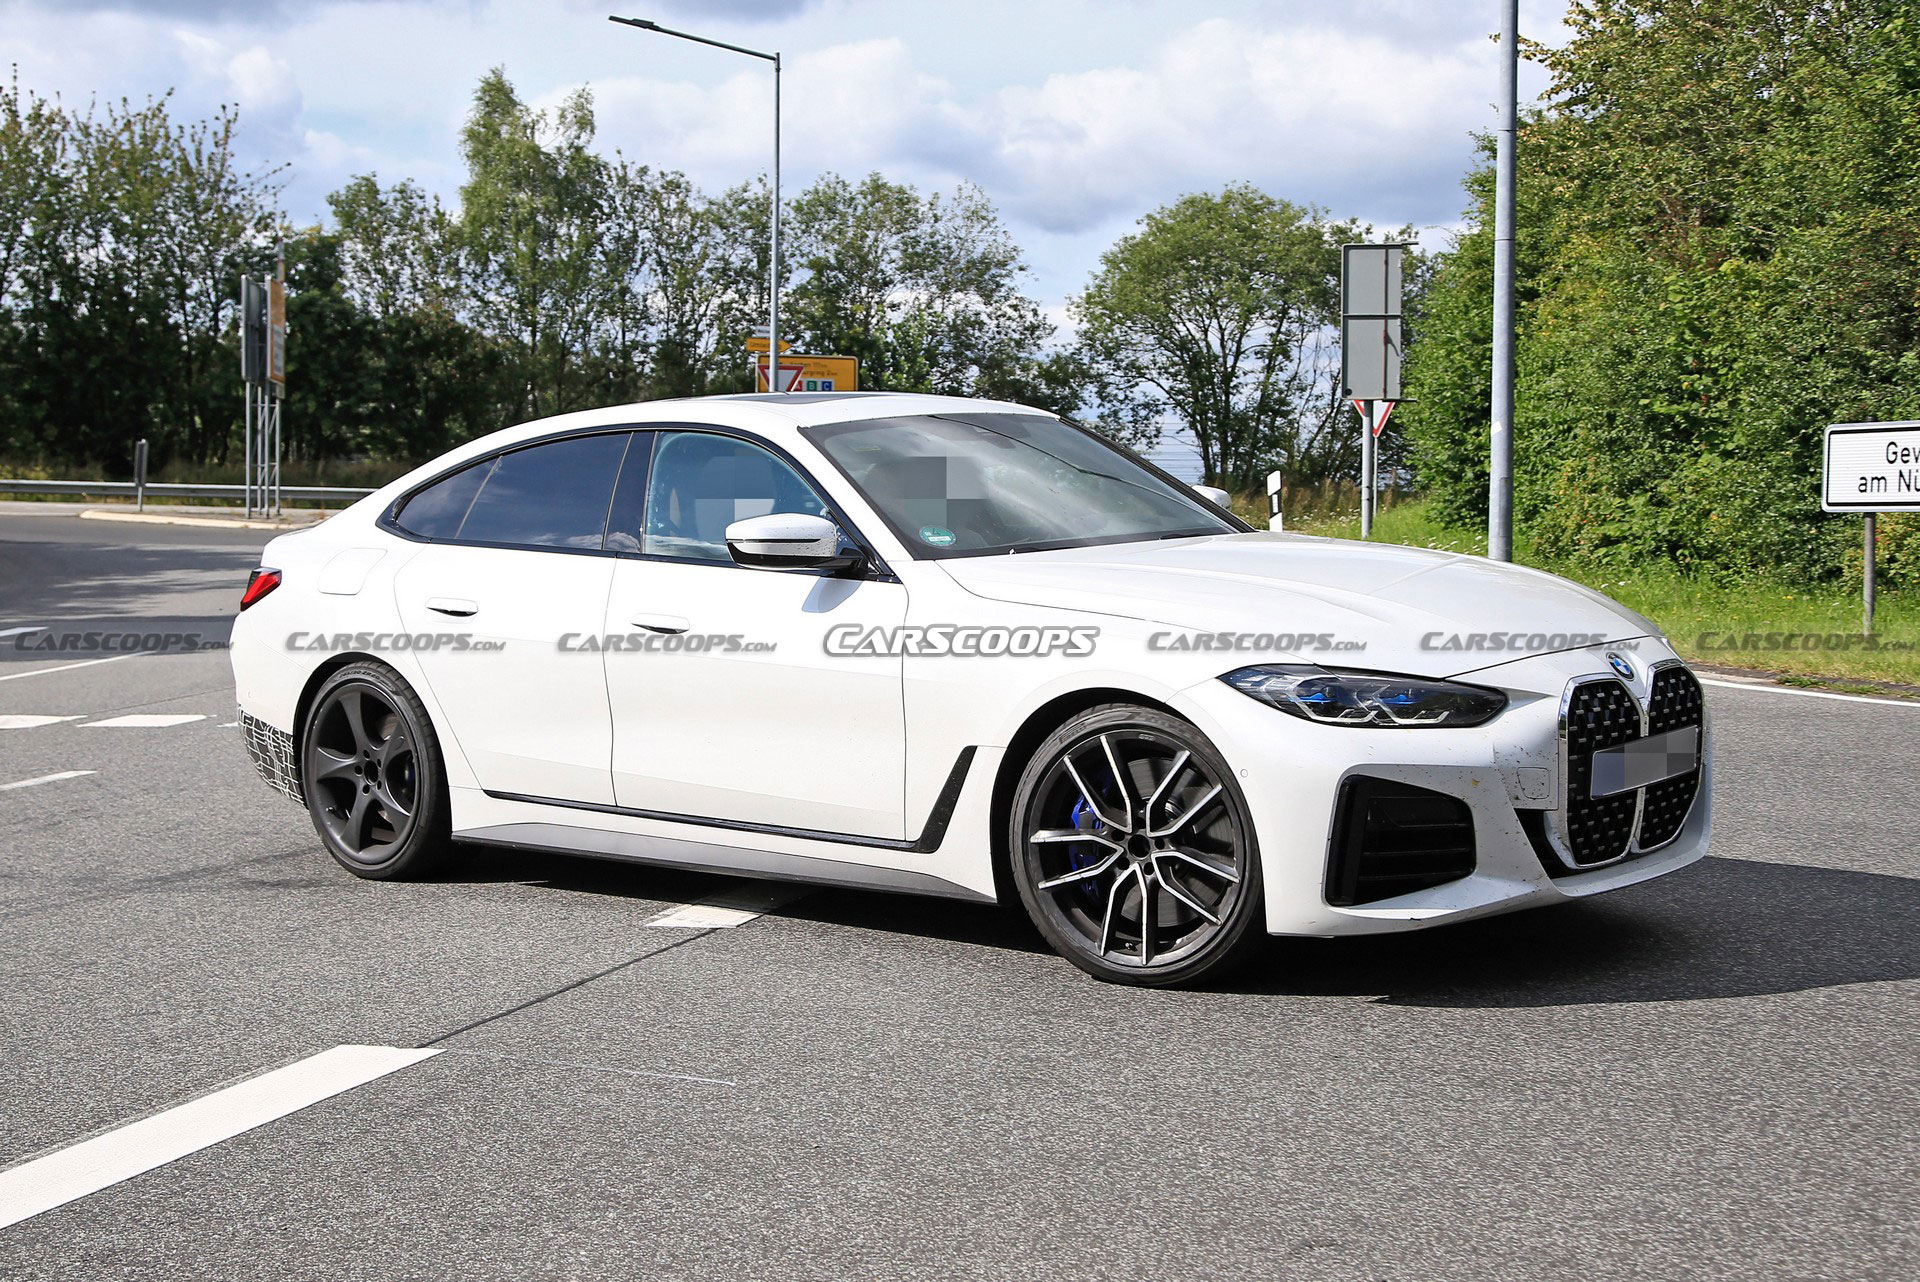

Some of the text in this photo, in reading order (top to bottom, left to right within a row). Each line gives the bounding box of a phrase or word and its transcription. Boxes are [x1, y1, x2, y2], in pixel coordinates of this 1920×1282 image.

[809, 382, 815, 390] B
[823, 382, 830, 391] C
[1858, 476, 1887, 493] am
